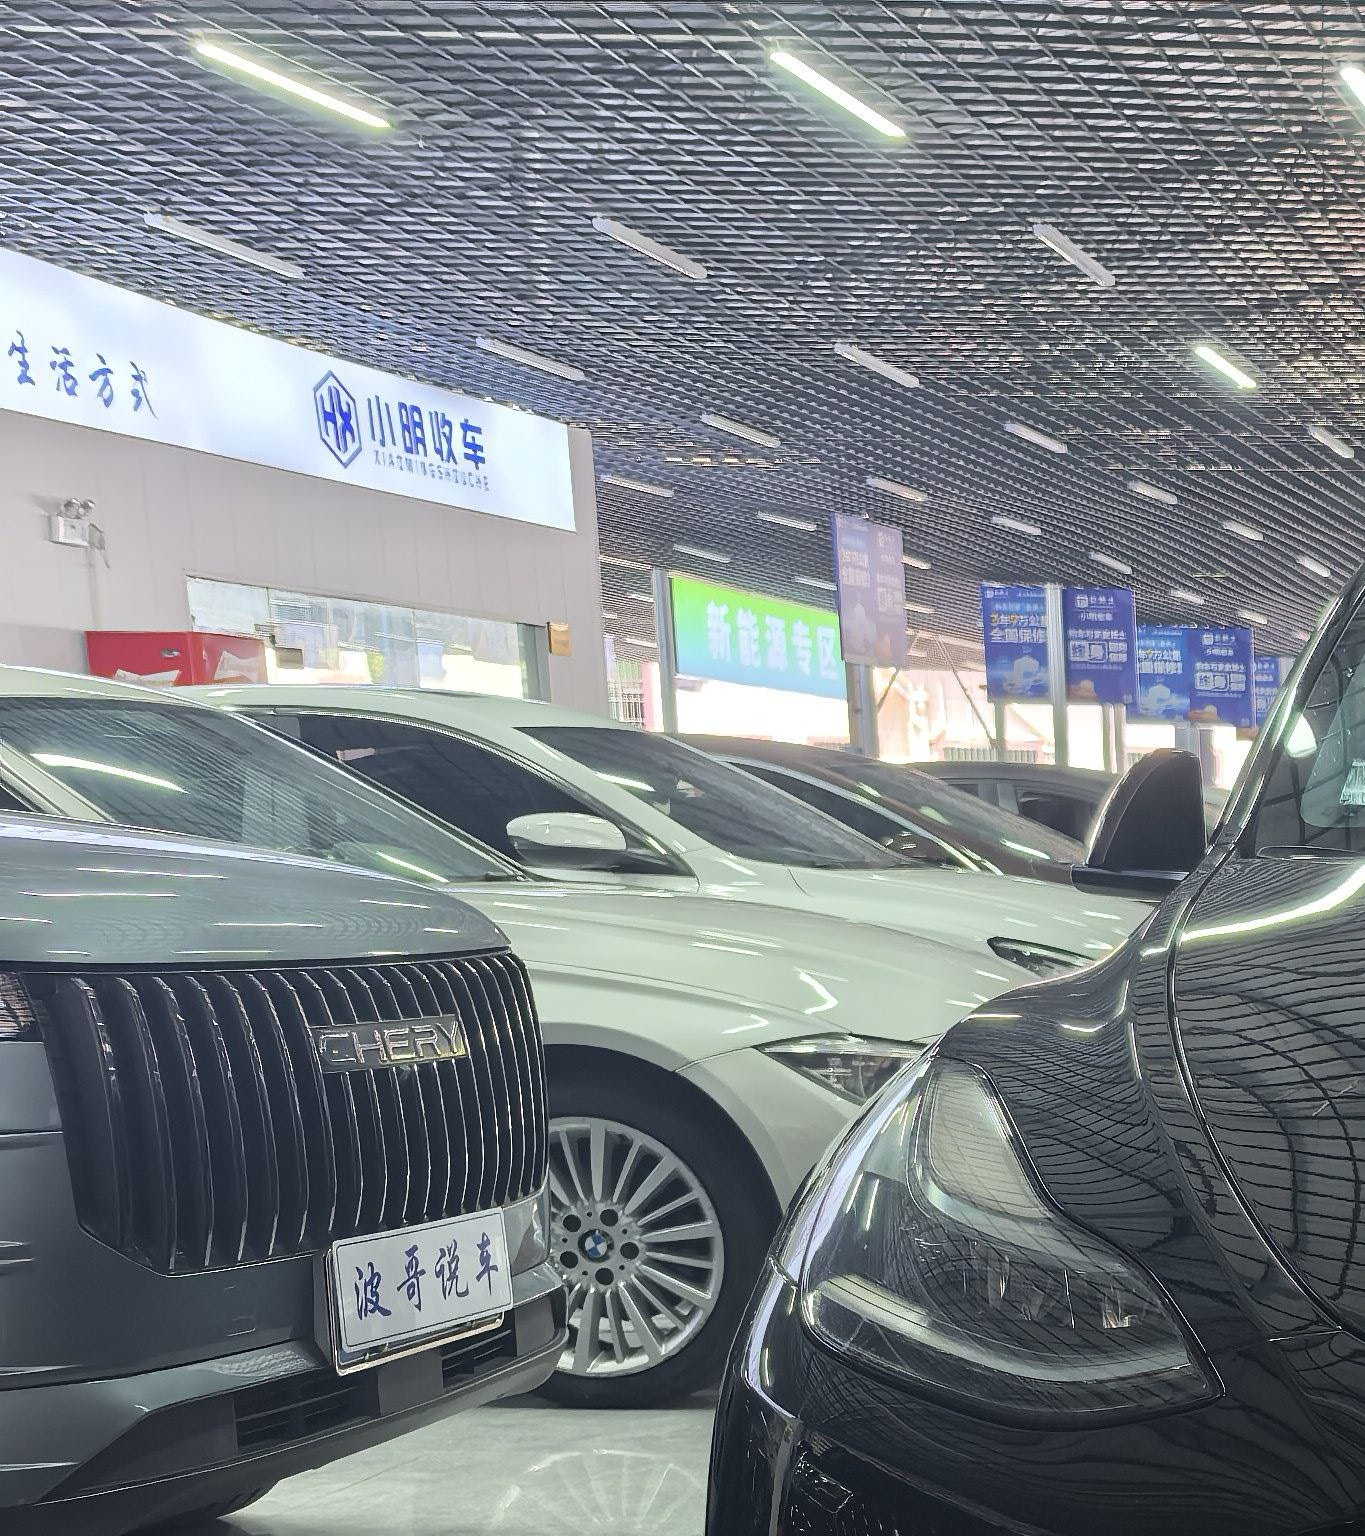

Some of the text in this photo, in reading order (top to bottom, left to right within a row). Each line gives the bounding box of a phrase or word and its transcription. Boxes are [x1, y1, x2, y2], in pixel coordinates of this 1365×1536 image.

[8, 330, 159, 430] 生活方式
[367, 394, 486, 471] 小明收车
[706, 600, 838, 681] 新能源专区
[319, 1019, 459, 1064] CHERY
[354, 1231, 500, 1321] 波哥说车
